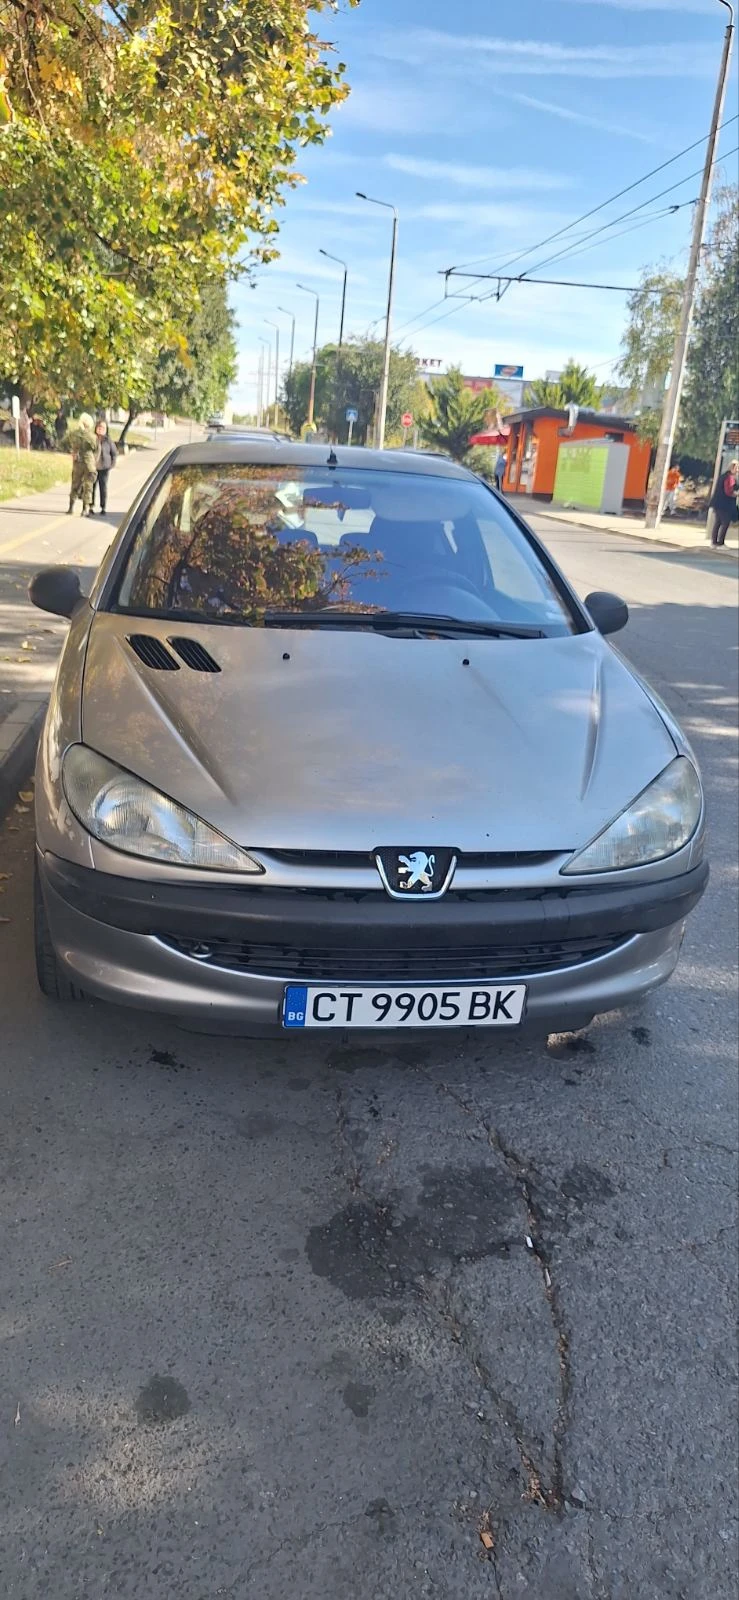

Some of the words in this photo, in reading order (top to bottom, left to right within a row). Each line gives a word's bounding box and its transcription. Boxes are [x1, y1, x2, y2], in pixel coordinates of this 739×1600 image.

[287, 1011, 304, 1021] BG
[312, 993, 363, 1022] CT
[372, 992, 461, 1022] 9905
[468, 990, 517, 1020] BK
